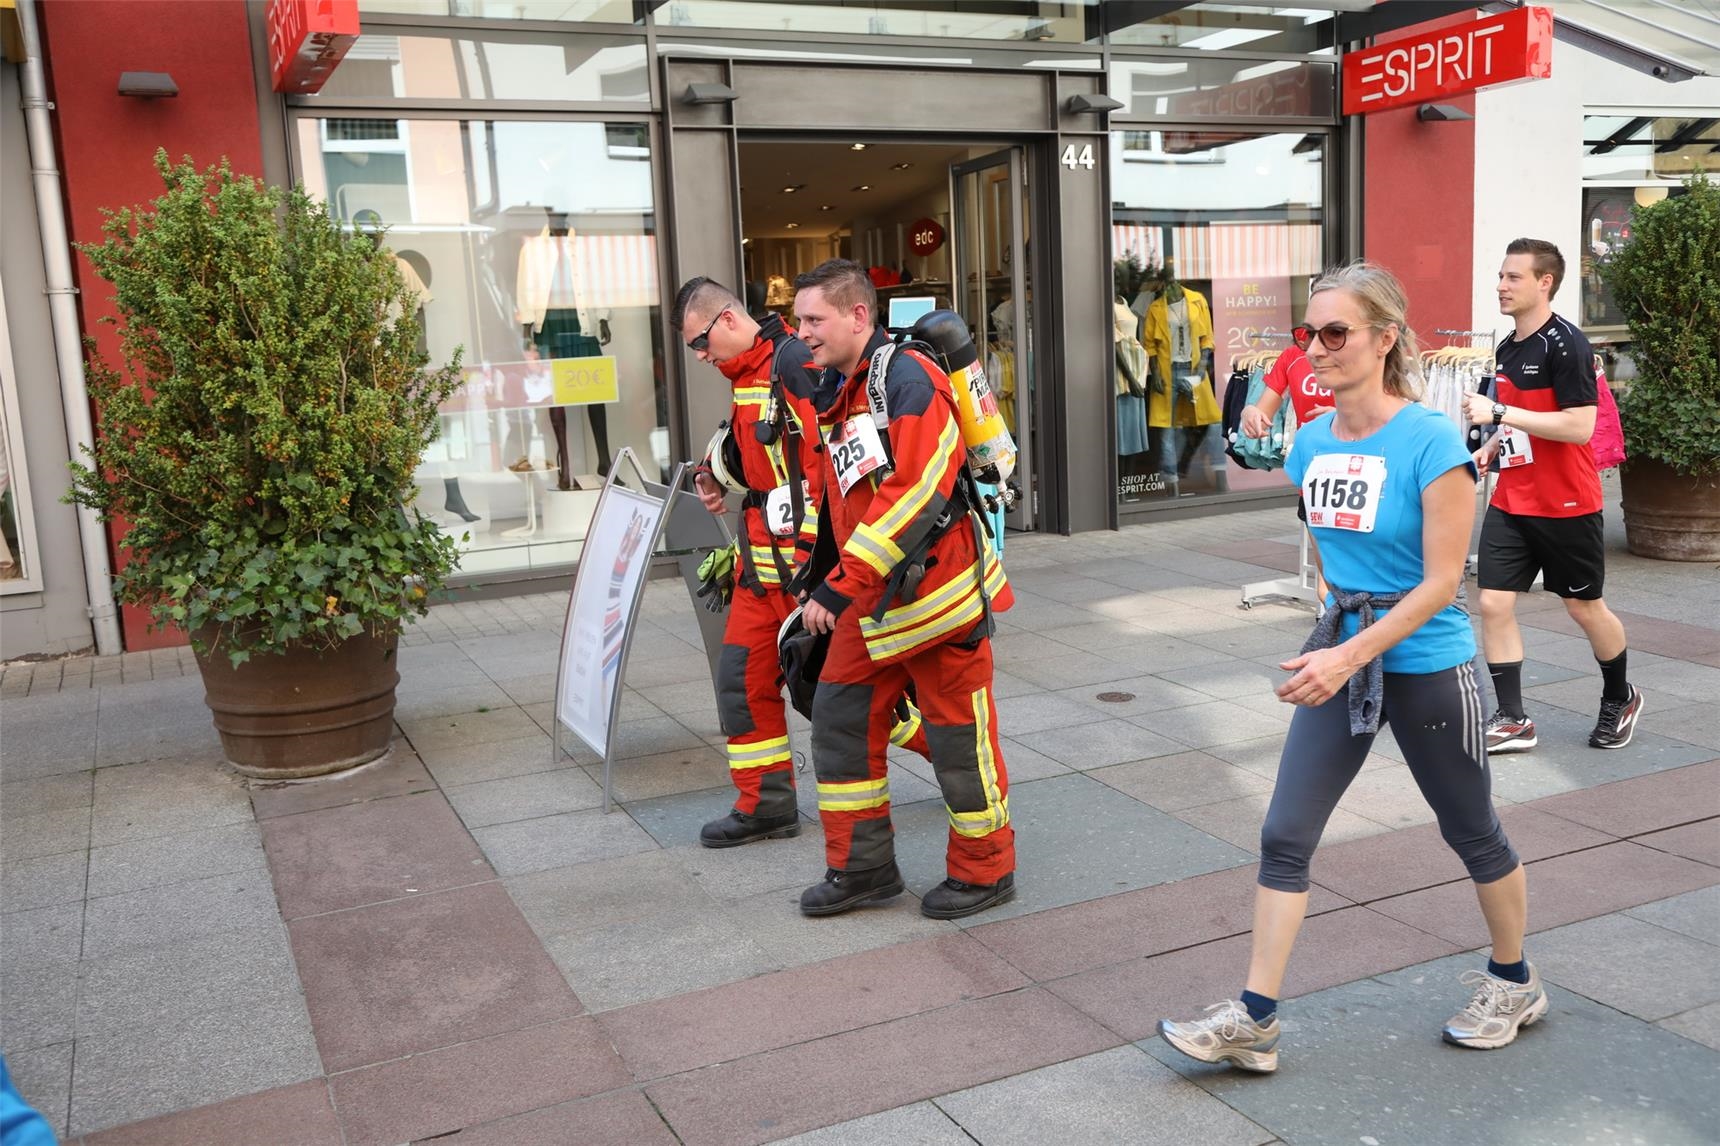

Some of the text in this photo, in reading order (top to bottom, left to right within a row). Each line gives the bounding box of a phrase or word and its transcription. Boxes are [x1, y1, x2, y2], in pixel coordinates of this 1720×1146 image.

[1361, 24, 1504, 102] ESPRIT
[1061, 144, 1096, 170] 44
[915, 229, 934, 246] edc
[1243, 284, 1260, 295] BE
[1225, 295, 1277, 308] HAPPY!
[564, 367, 605, 389] 20€
[832, 436, 866, 478] 225
[1121, 473, 1160, 485] SHOP AT
[1117, 481, 1165, 495] ESPRIT.COM
[1308, 478, 1369, 510] 1158
[1310, 512, 1323, 521] SEW
